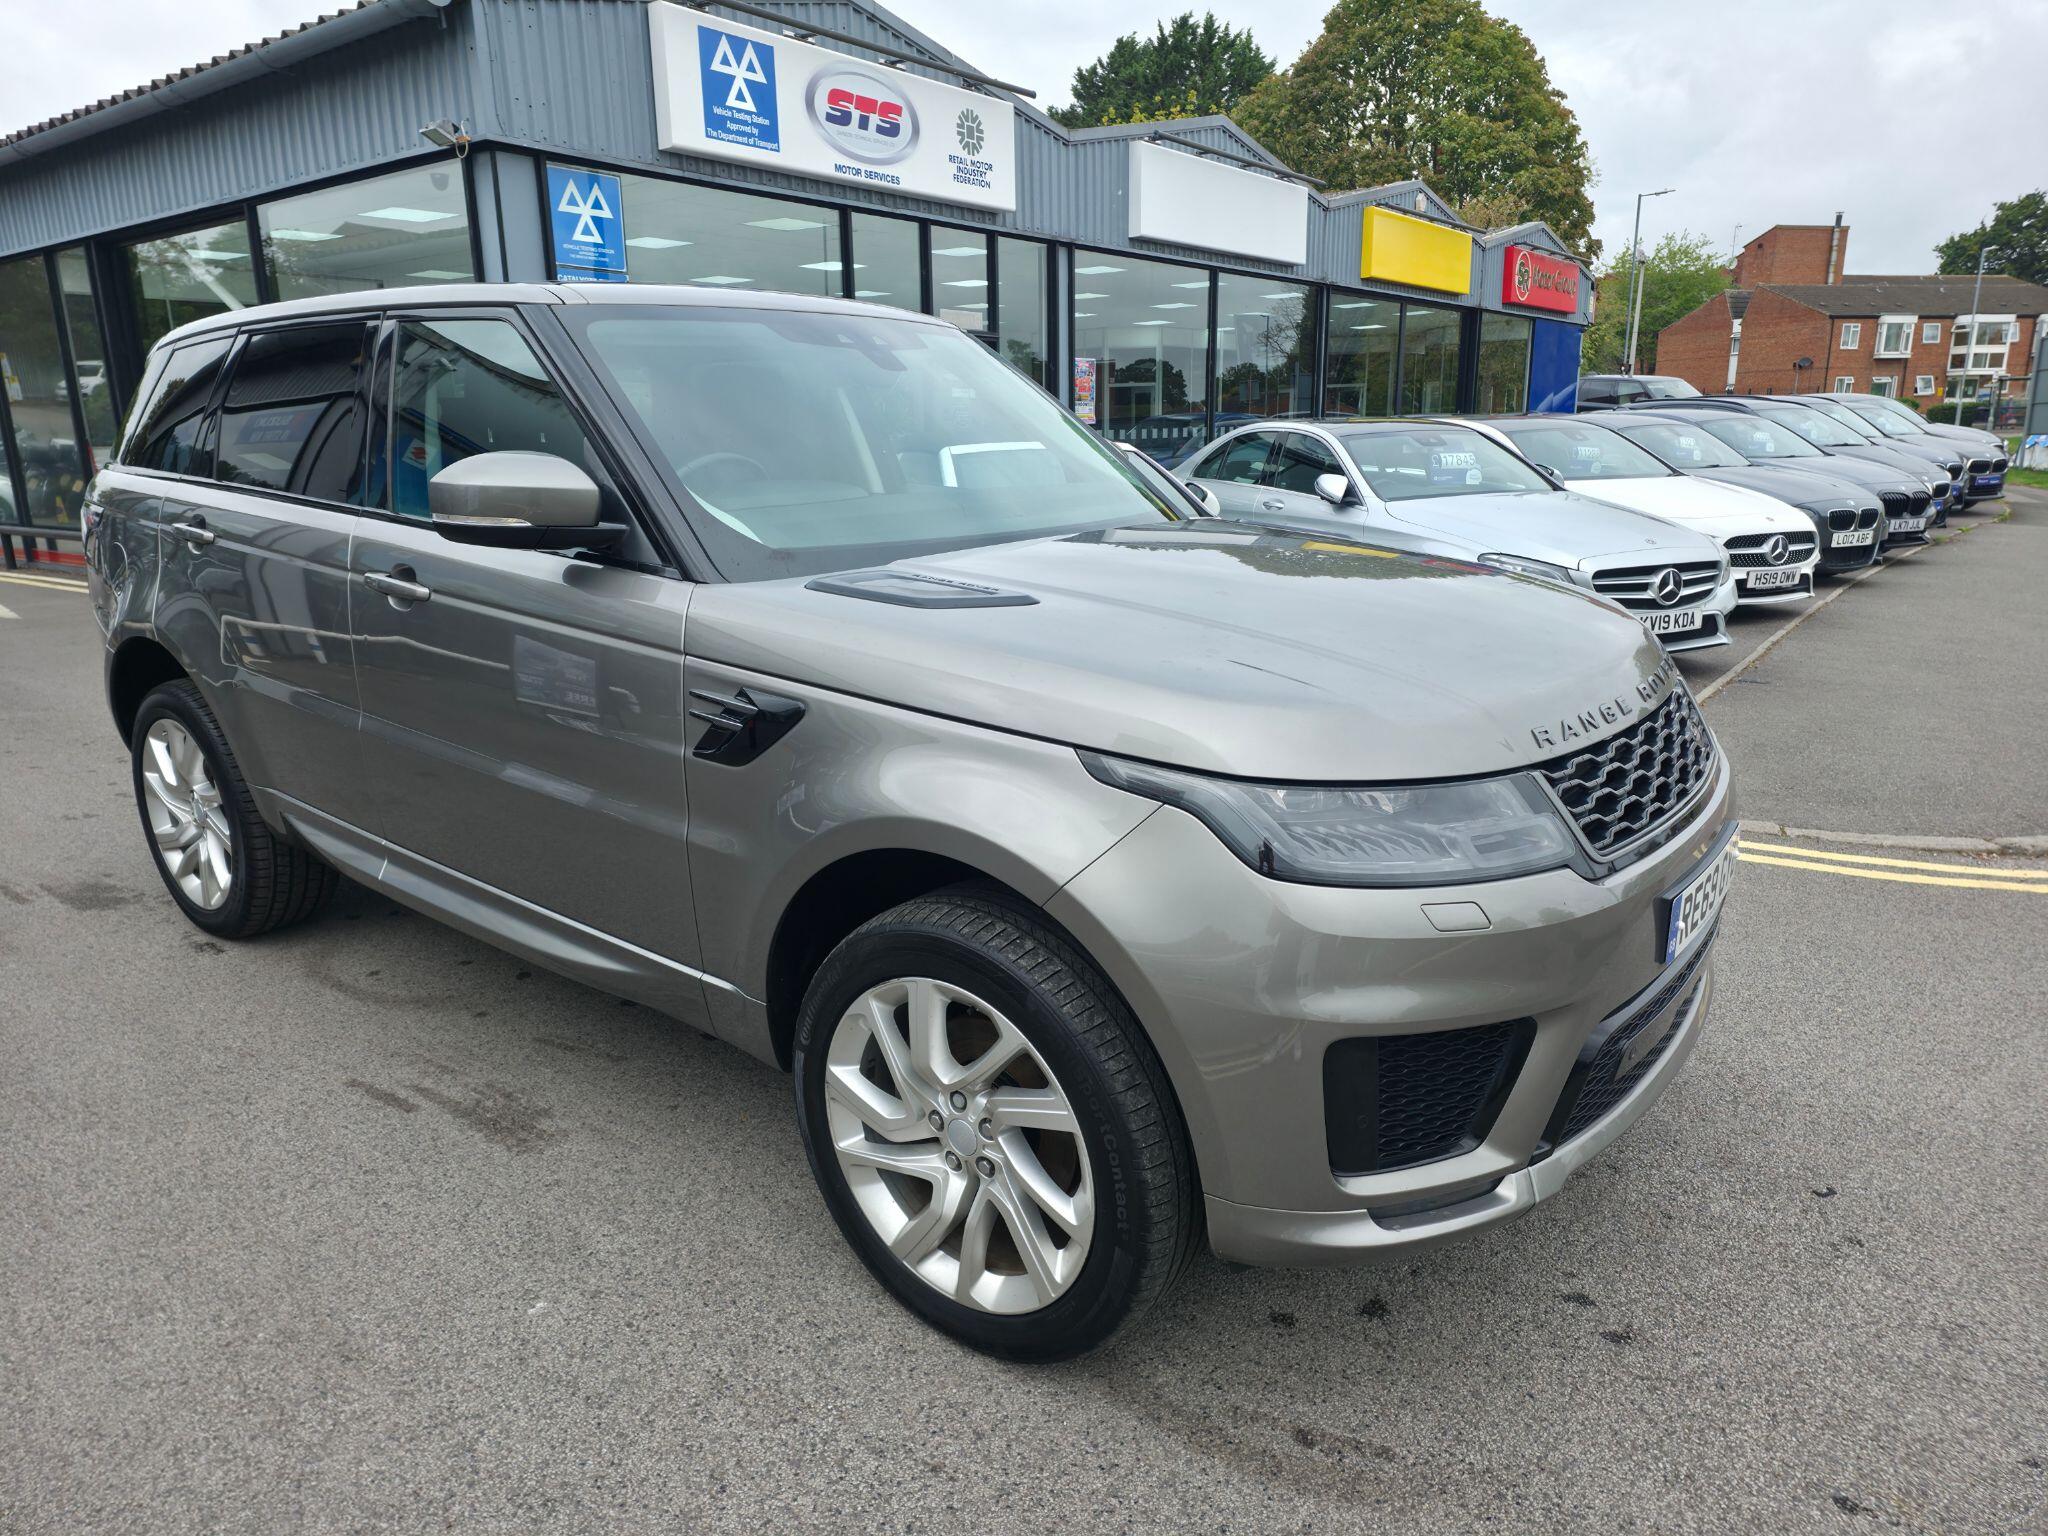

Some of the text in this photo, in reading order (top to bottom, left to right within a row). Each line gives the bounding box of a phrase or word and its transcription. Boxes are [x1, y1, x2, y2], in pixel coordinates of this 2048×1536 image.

[712, 105, 770, 126] Vehicle Testing Station
[825, 88, 903, 138] STS
[726, 120, 759, 136] Approved by
[707, 128, 718, 138] The
[718, 131, 748, 144] Department
[754, 138, 779, 150] Transport
[948, 154, 993, 172] RETAIL MOTOR
[956, 165, 987, 179] INDUSTRY
[834, 163, 900, 185] MOTOR SERVICES
[953, 173, 991, 189] FEDERATION
[1754, 571, 1777, 586] HS19
[1674, 612, 1696, 628] KDA
[1531, 696, 1633, 749] RANGE
[1679, 864, 1720, 945] RE69
